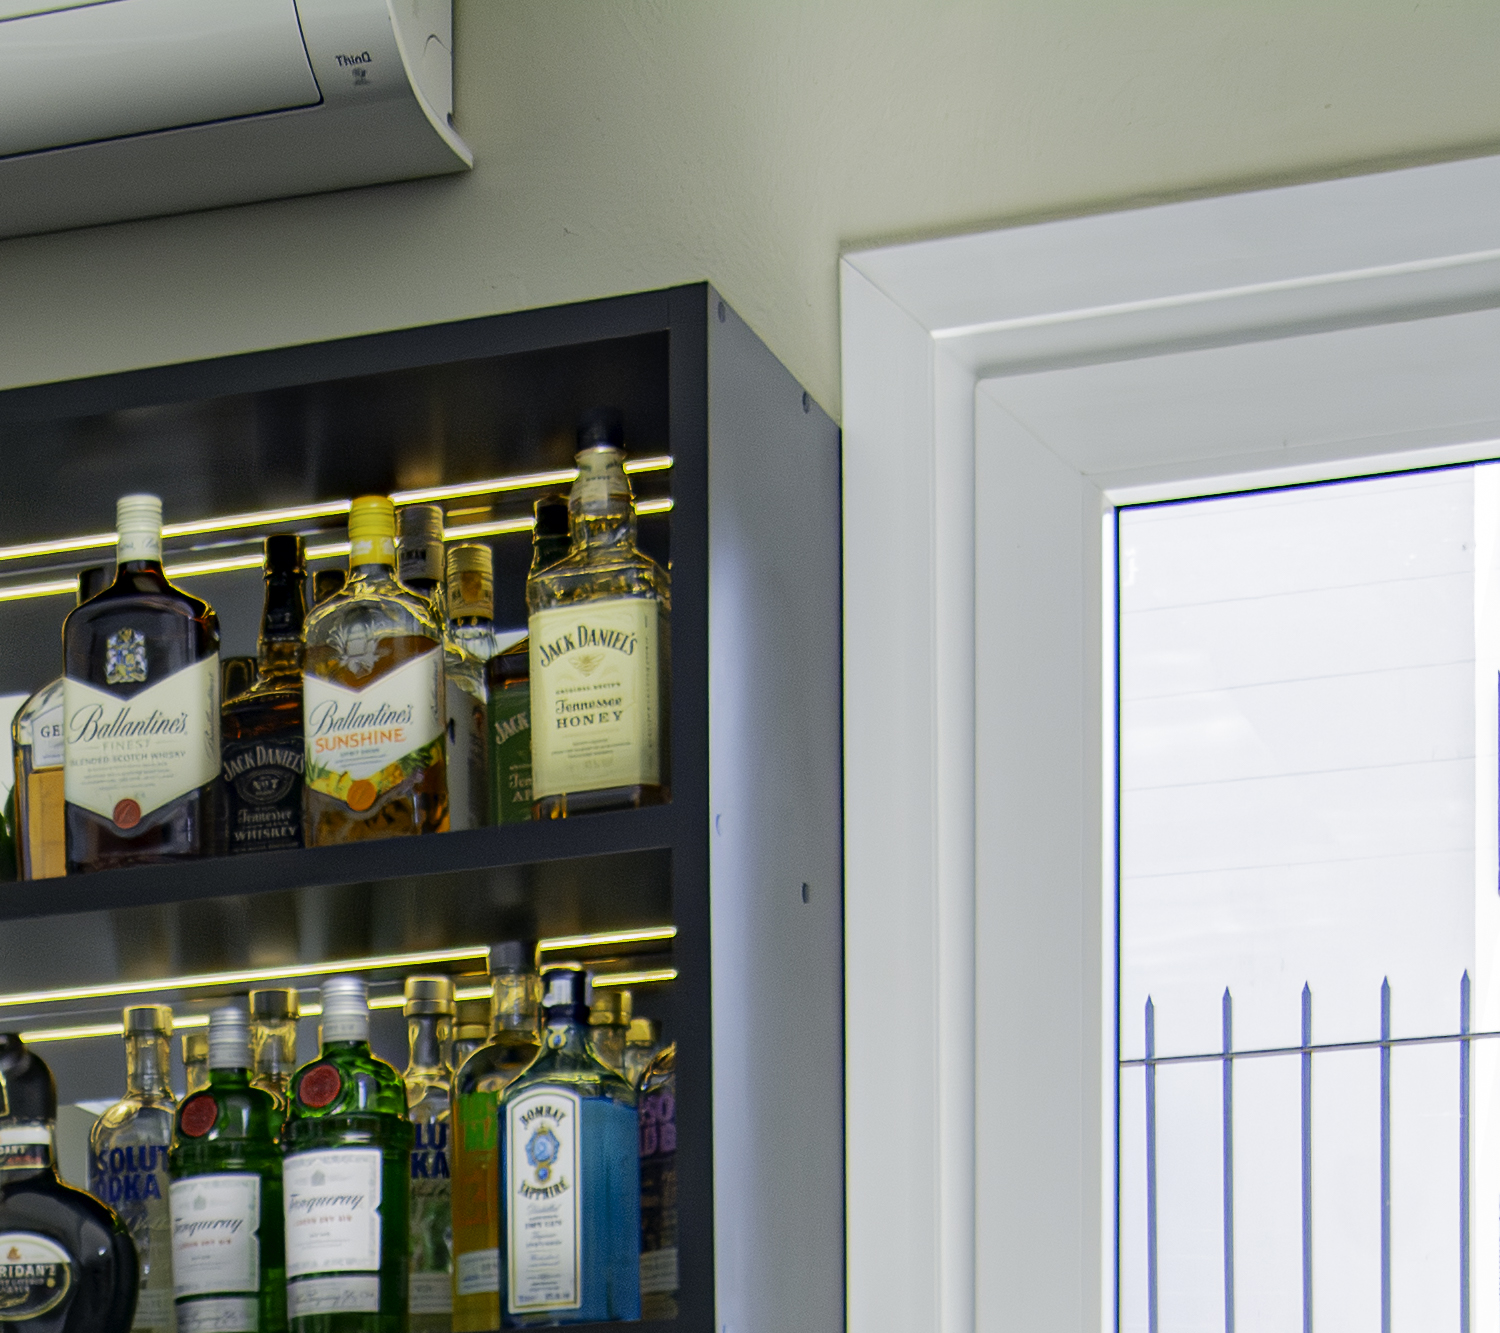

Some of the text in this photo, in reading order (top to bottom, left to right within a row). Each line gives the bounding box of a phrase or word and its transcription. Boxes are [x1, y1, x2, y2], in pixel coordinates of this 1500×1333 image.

[335, 51, 372, 67] ThinQ
[539, 624, 639, 668] JACK DANIEL'S
[554, 697, 622, 715] Tennessee
[40, 723, 65, 739] GE
[67, 702, 189, 745] Ballantine's
[308, 700, 414, 738] Ballantine's
[555, 709, 625, 730] HONEY
[102, 740, 150, 751] FINEST
[315, 727, 407, 754] SUNSHINE
[222, 751, 256, 781] JACK
[519, 1105, 567, 1129] BOMBAY
[91, 1145, 169, 1176] SOLUT
[95, 1174, 162, 1202] ODKA
[517, 1176, 570, 1201] SAPPHIRE
[288, 1192, 364, 1214] Tanqueray
